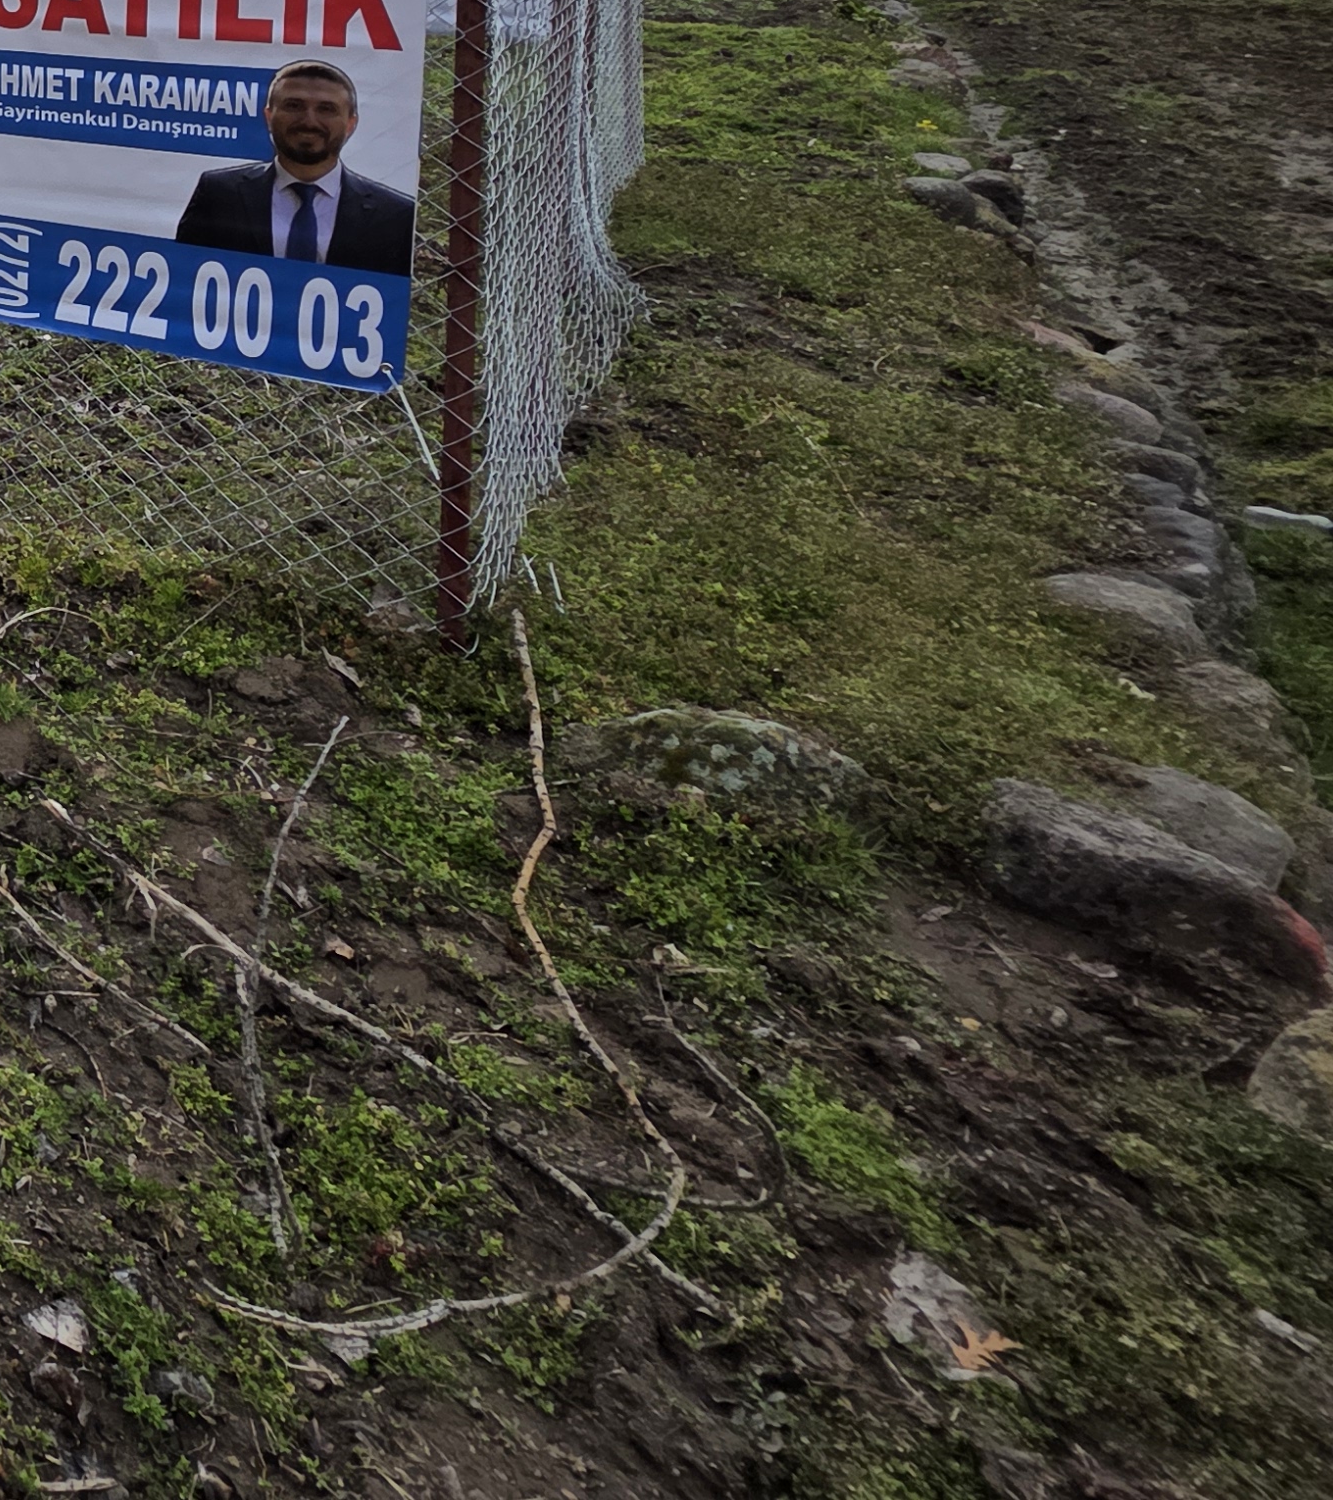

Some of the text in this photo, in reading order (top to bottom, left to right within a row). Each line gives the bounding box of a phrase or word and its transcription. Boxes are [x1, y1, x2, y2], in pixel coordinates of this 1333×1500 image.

[93, 70, 259, 117] KARAMAN
[122, 114, 238, 139] Danışmanı
[54, 240, 384, 378] 222 00 03
